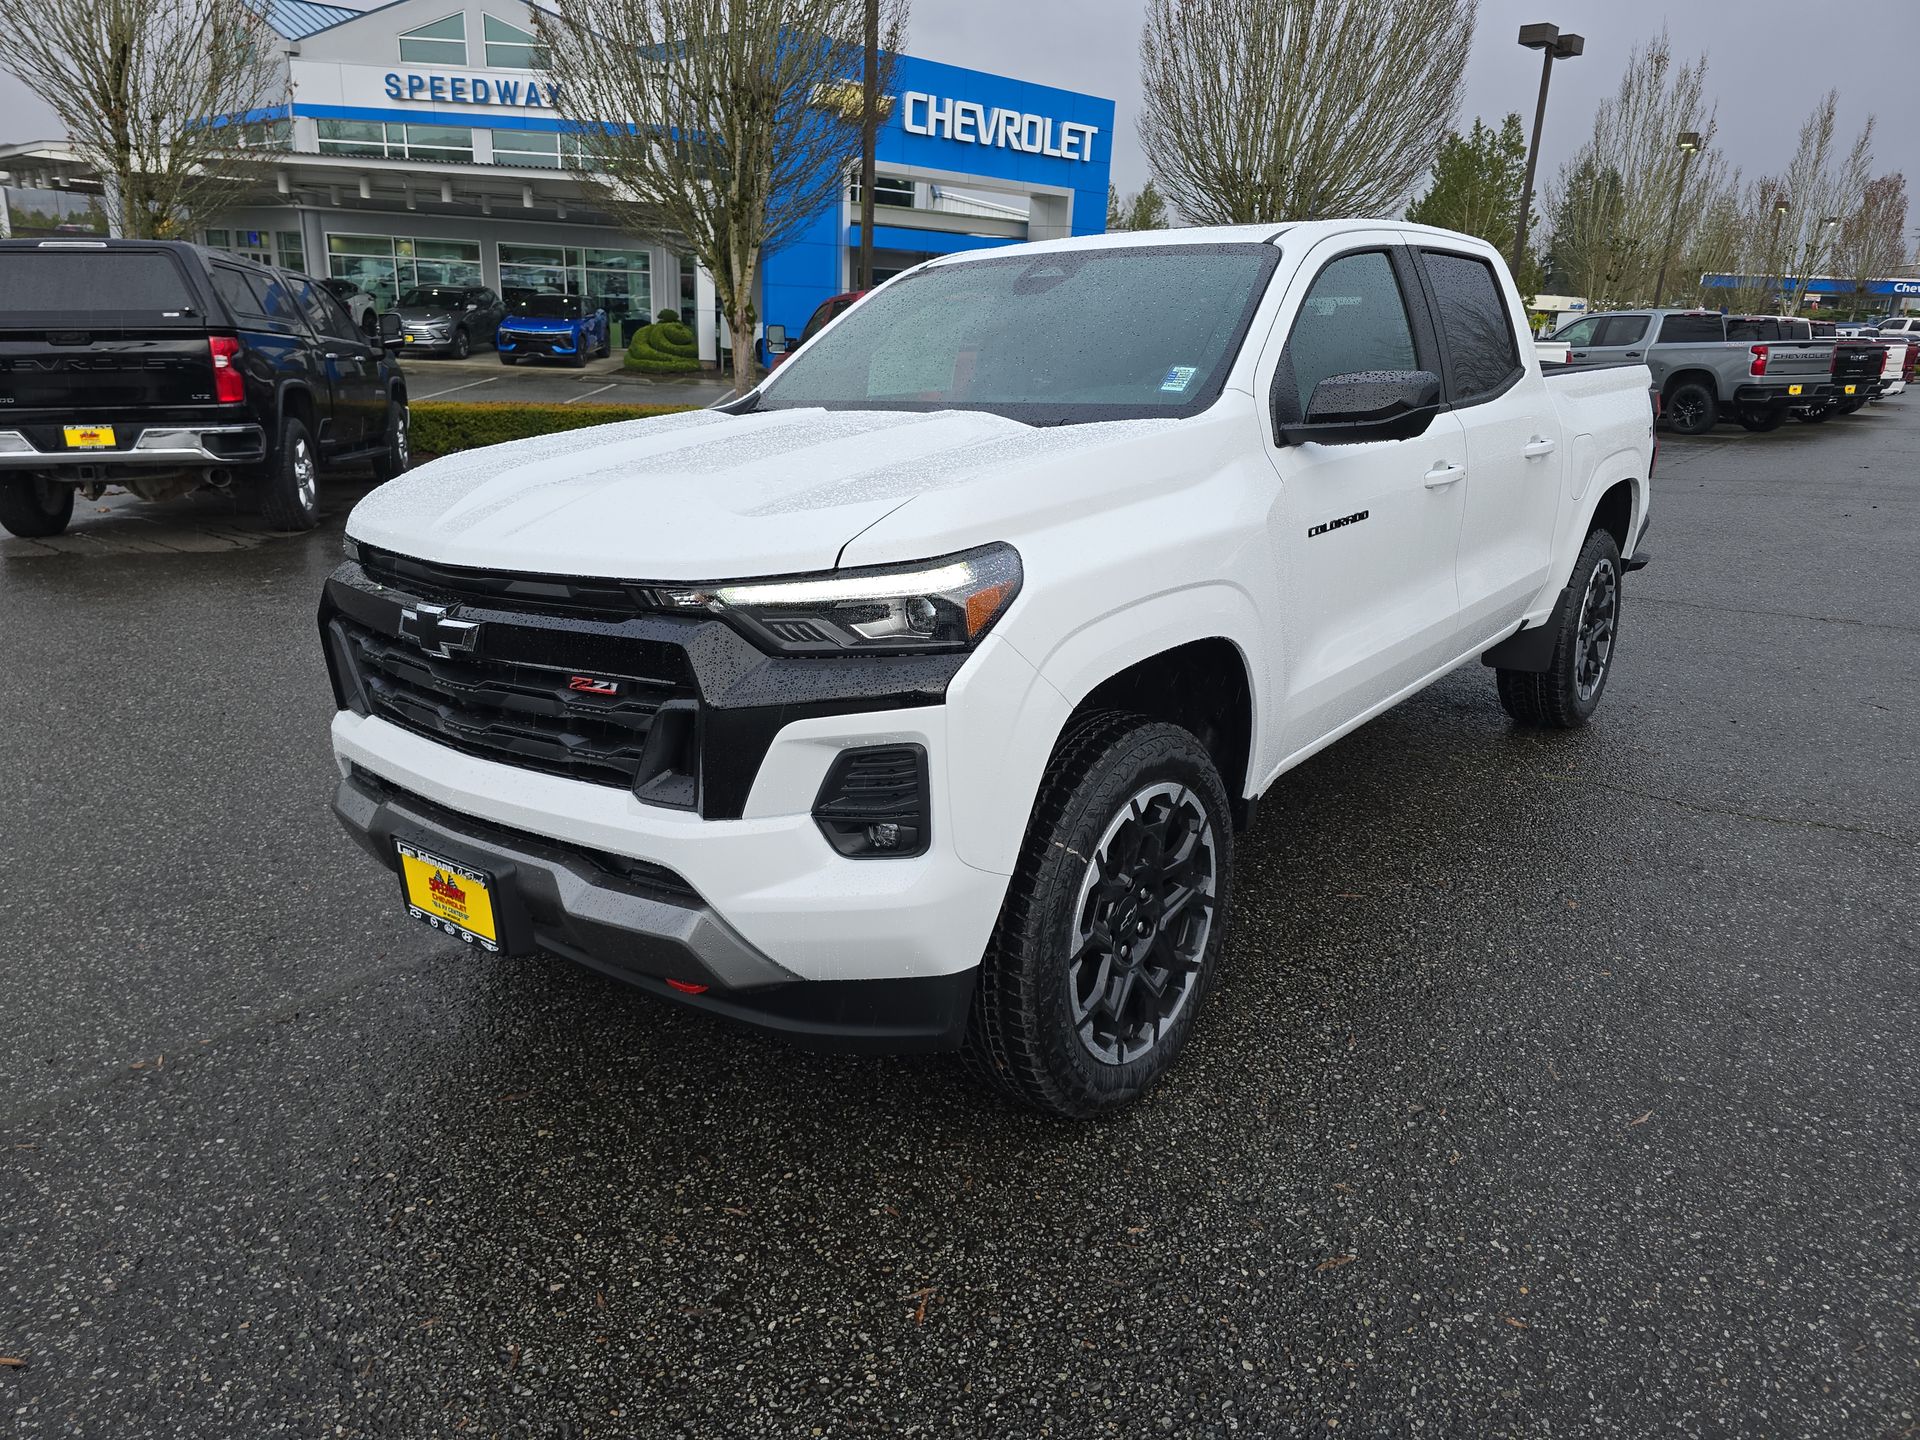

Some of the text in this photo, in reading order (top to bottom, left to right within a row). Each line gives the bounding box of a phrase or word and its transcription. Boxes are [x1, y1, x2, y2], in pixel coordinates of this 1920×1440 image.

[384, 73, 562, 108] SPEEDWAY
[904, 90, 1099, 162] CHEVROLET
[1894, 282, 1920, 293] Che
[1308, 509, 1369, 538] COLORADO
[569, 675, 619, 695] Z71
